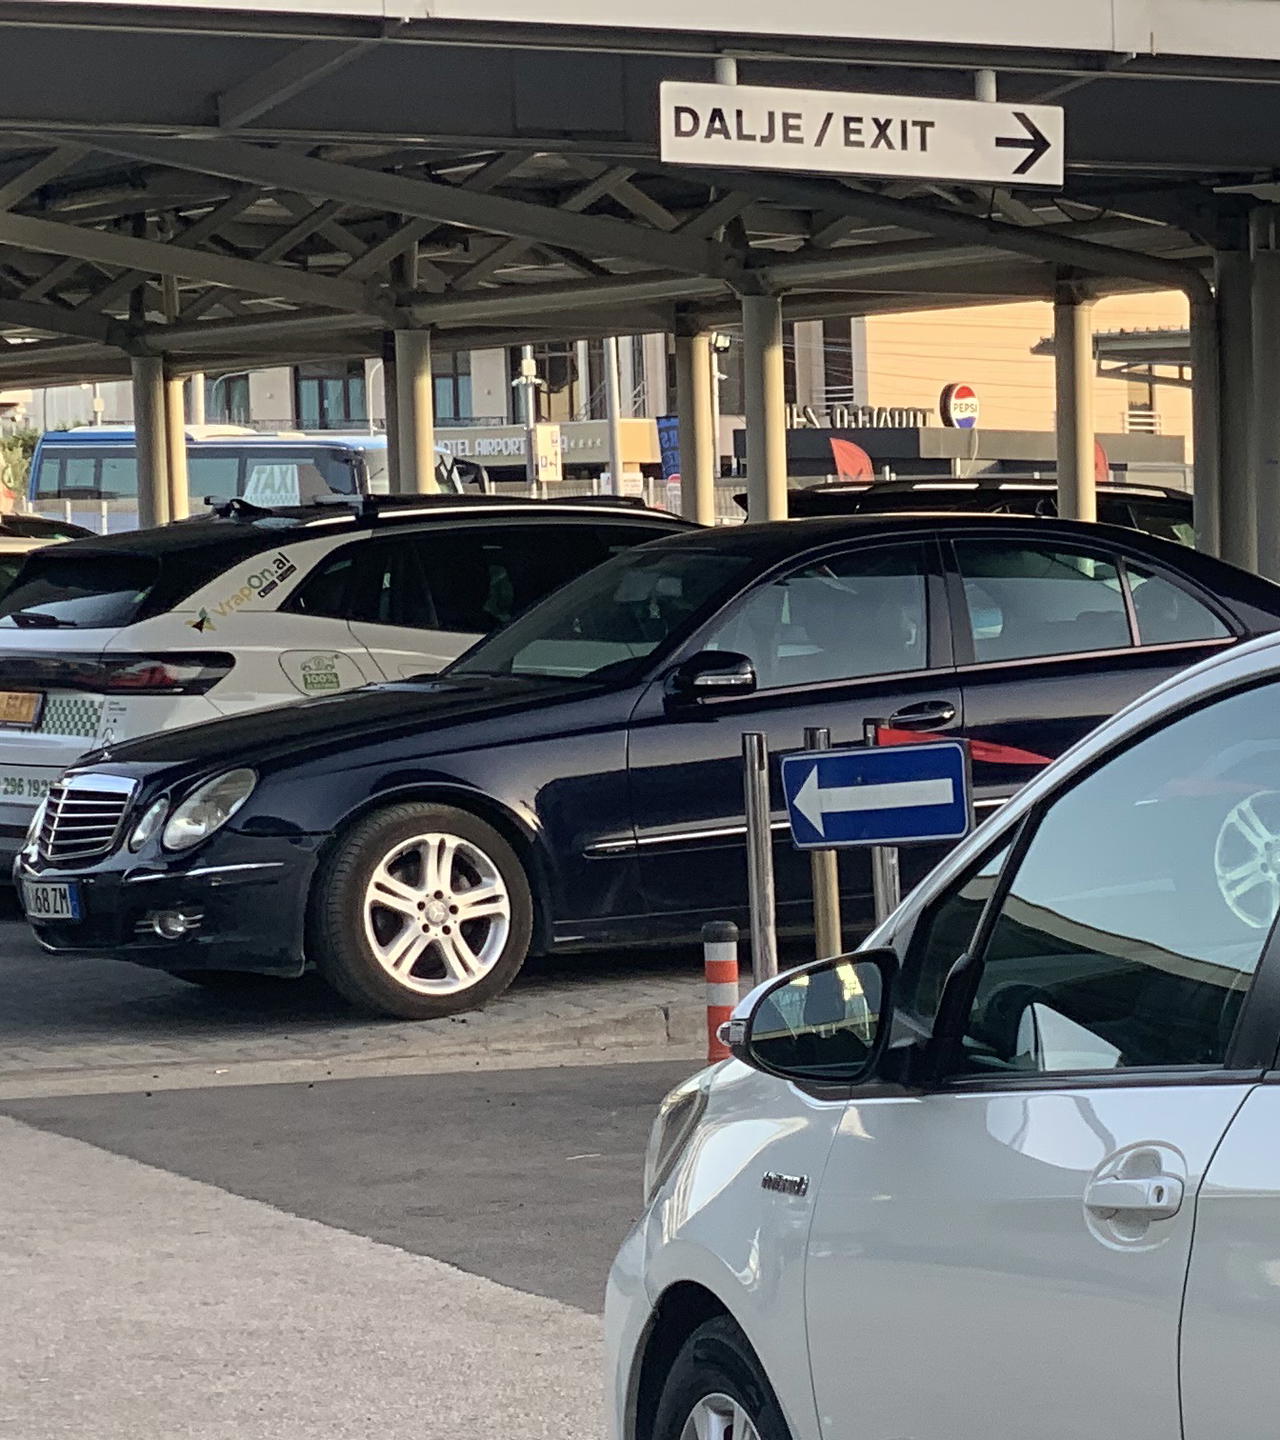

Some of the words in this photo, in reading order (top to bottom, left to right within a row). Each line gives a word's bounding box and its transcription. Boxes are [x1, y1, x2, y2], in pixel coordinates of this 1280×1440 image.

[953, 402, 977, 413] PEPSI
[475, 437, 527, 456] AIRPORT
[253, 465, 296, 494] TAXI
[305, 674, 337, 684] 100%
[27, 779, 54, 798] 192
